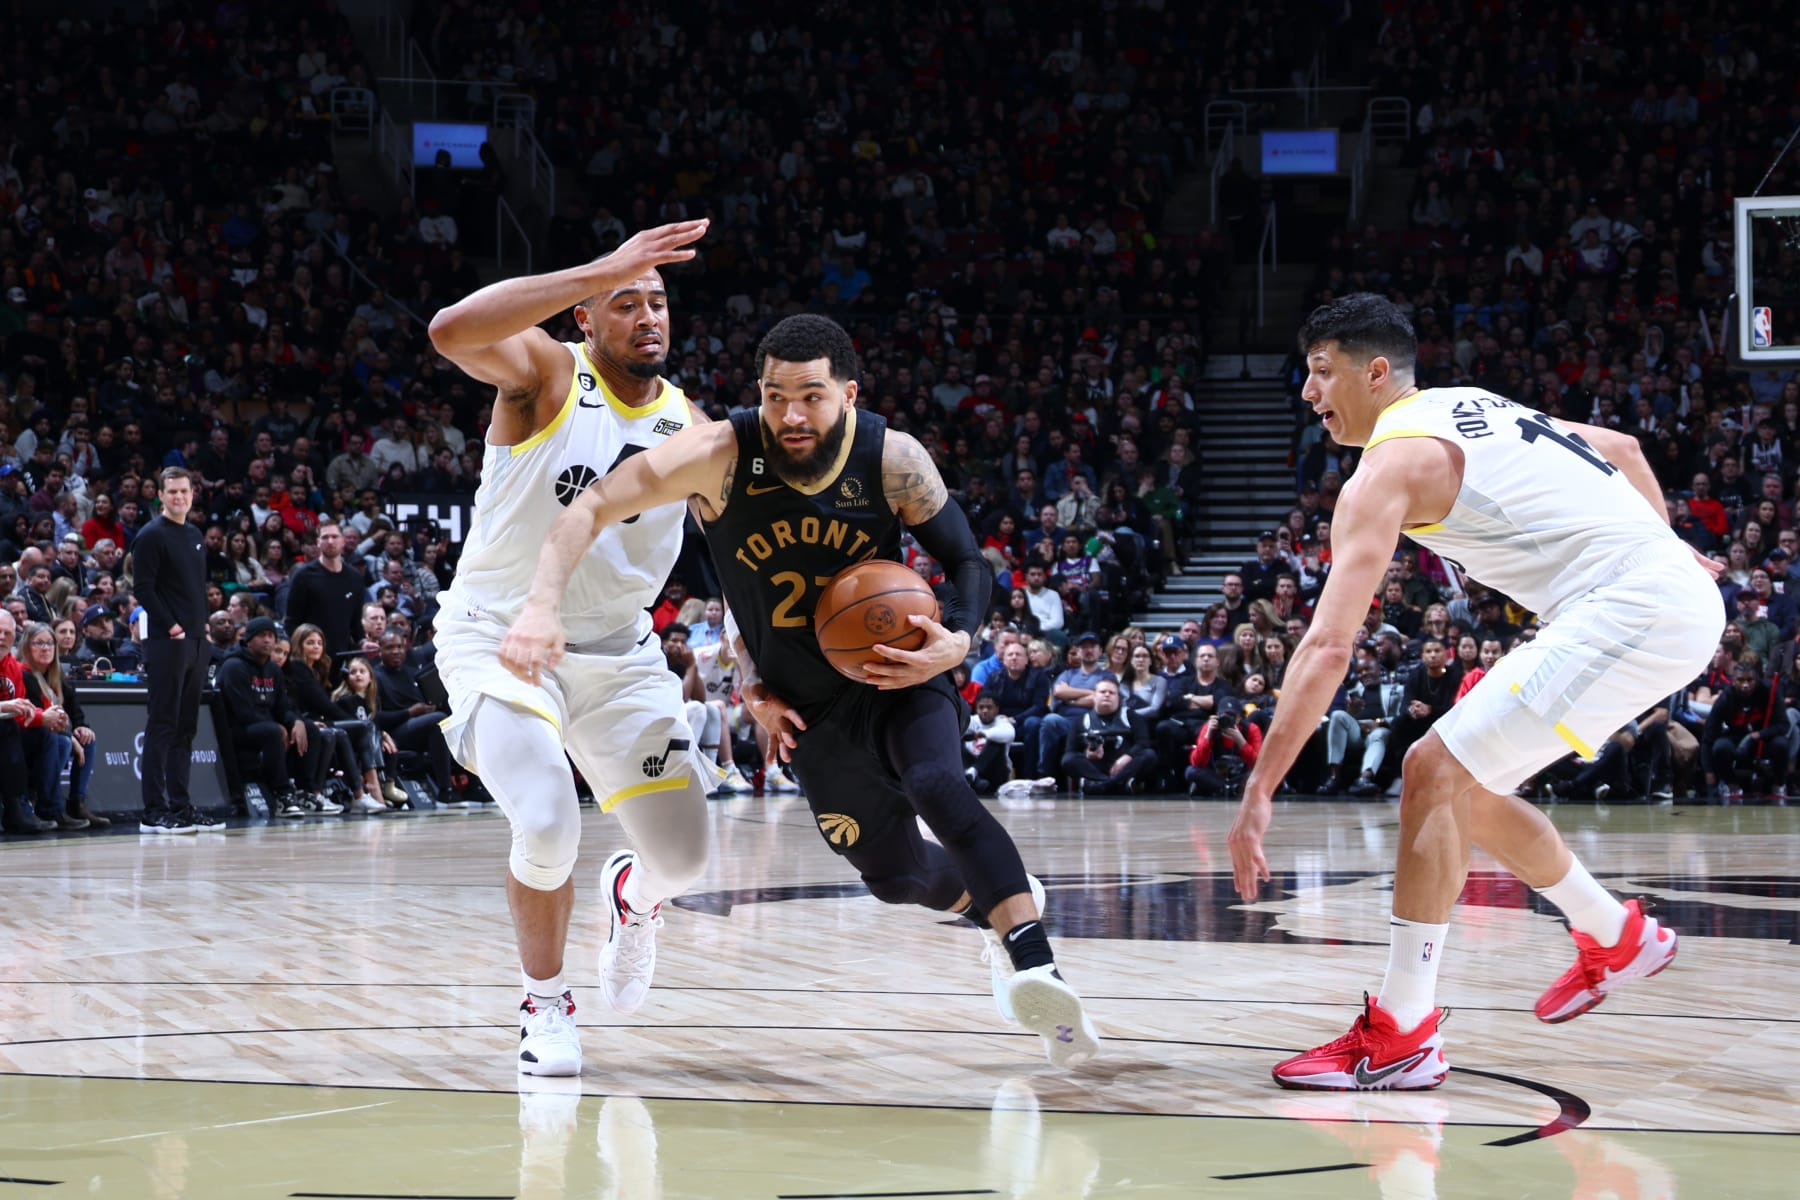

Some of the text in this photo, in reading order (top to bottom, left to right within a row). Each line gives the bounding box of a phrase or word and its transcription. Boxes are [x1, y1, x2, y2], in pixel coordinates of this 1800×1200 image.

[580, 375, 591, 390] 6
[752, 457, 765, 475] 6
[835, 498, 870, 508] Sun Life
[770, 571, 833, 627] 2
[105, 752, 130, 765] BUILT
